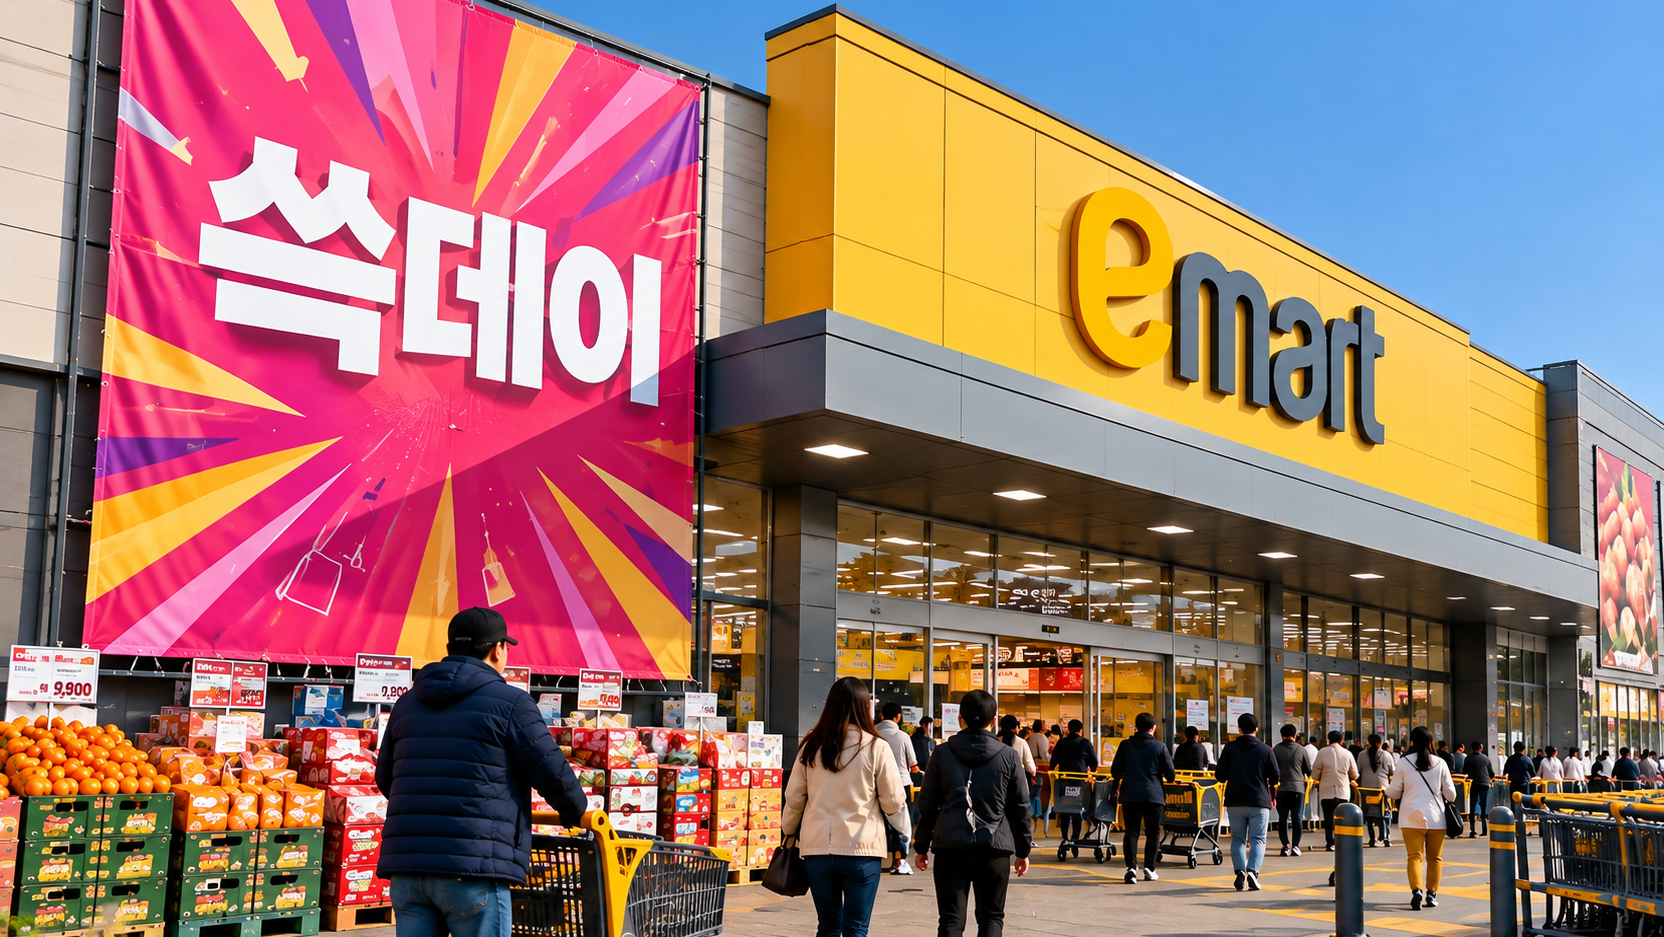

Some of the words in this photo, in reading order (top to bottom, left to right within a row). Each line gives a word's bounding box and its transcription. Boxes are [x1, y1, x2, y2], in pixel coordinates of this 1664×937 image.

[199, 136, 661, 407] 쓱데이
[1070, 187, 1385, 445] emart
[53, 681, 92, 698] 9,900
